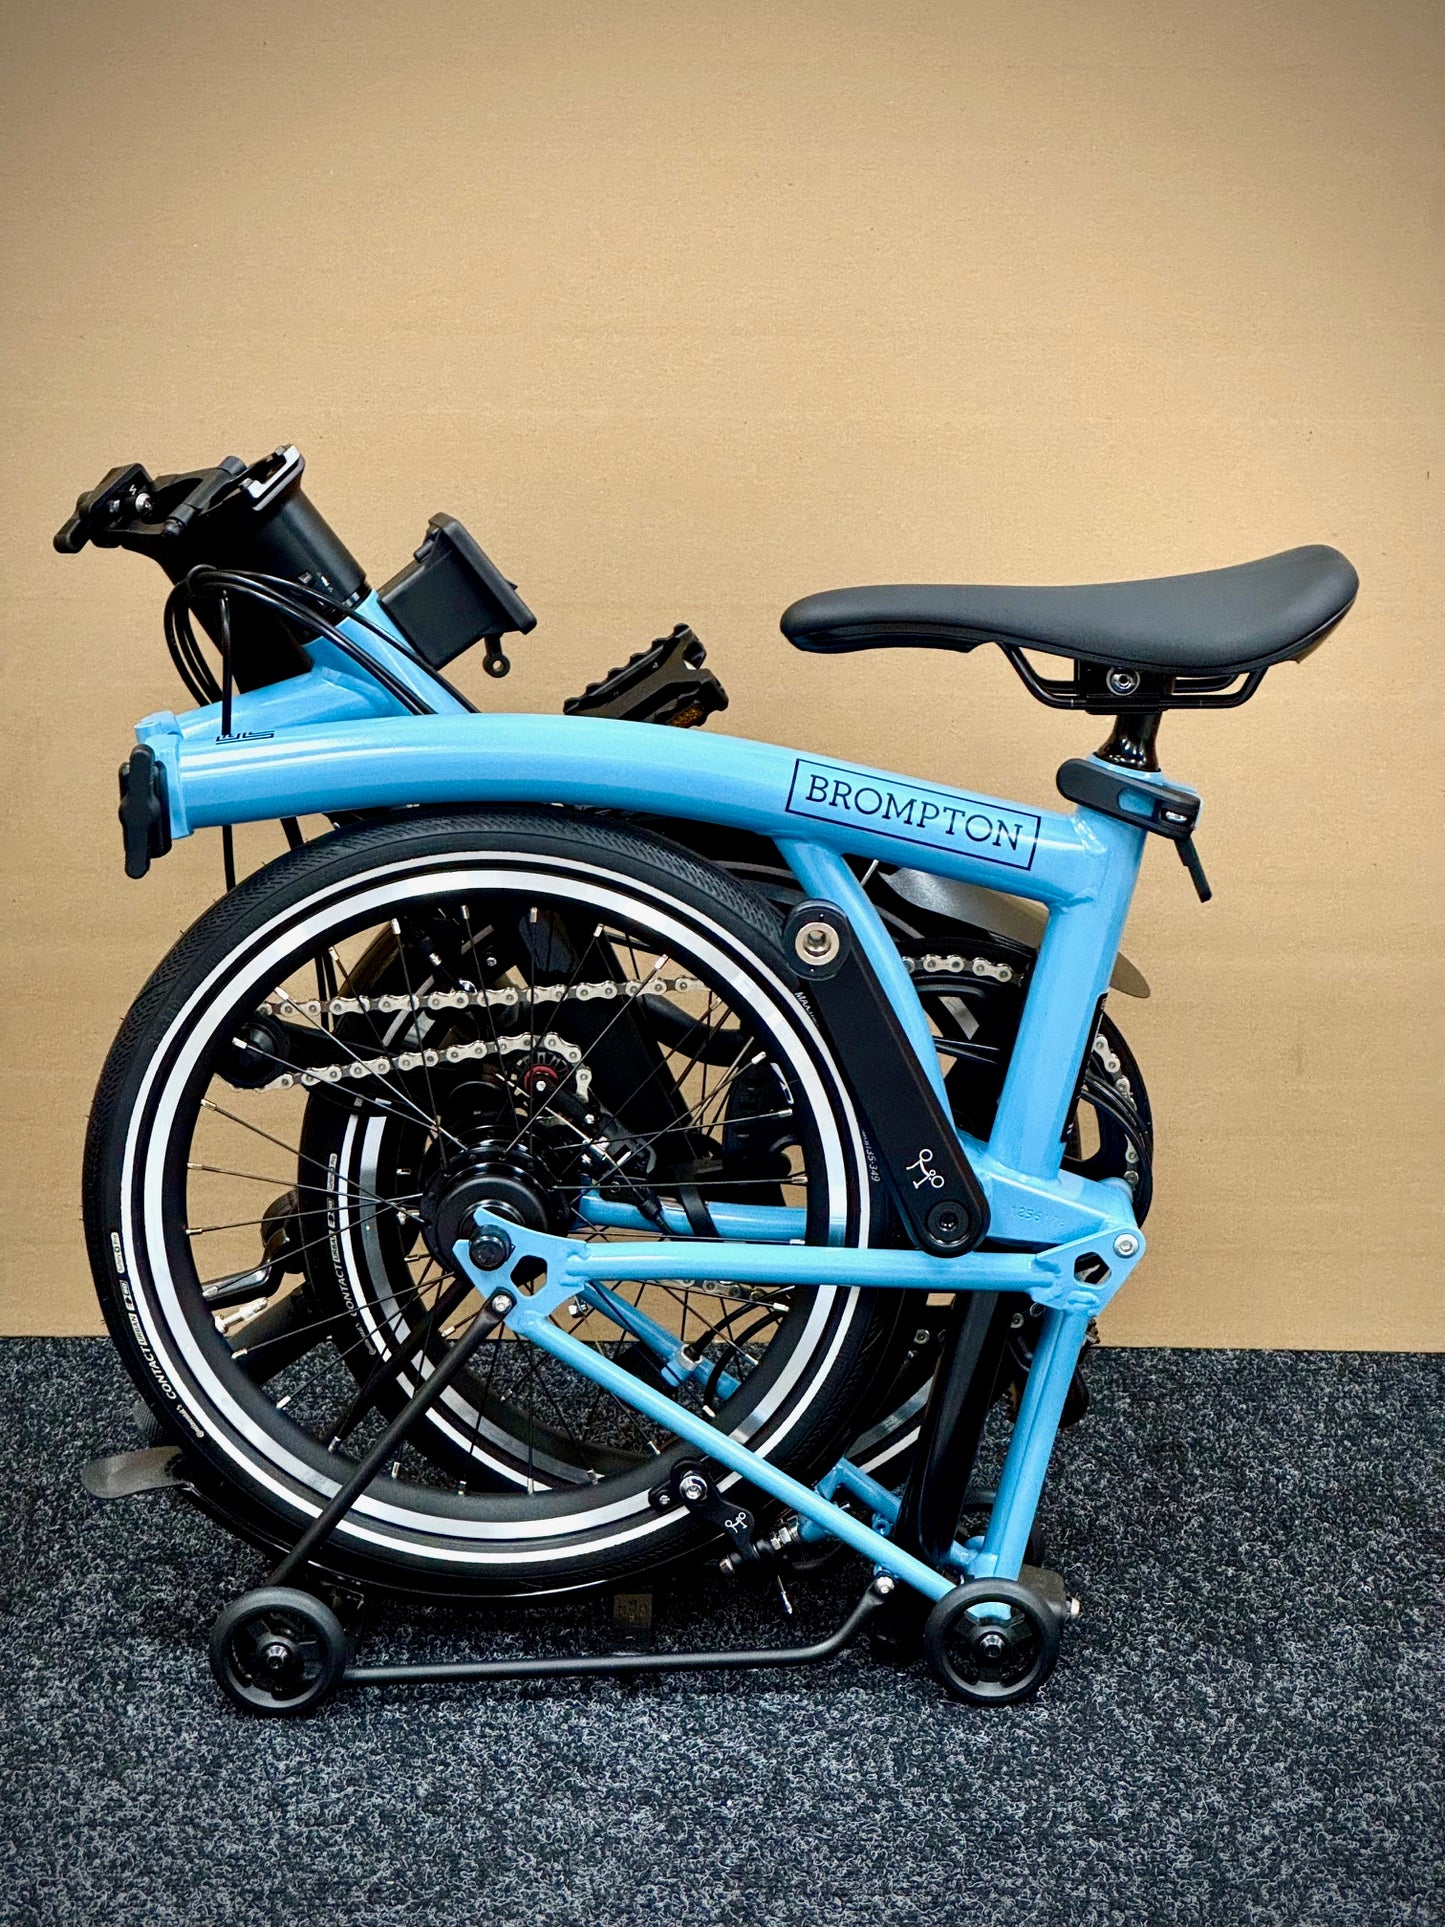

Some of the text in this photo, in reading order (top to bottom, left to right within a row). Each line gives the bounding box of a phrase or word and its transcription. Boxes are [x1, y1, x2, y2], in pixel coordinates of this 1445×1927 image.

[805, 774, 1023, 851] BROMPTON
[130, 1315, 146, 1343] URBAN
[140, 1345, 177, 1400] CONTACT
